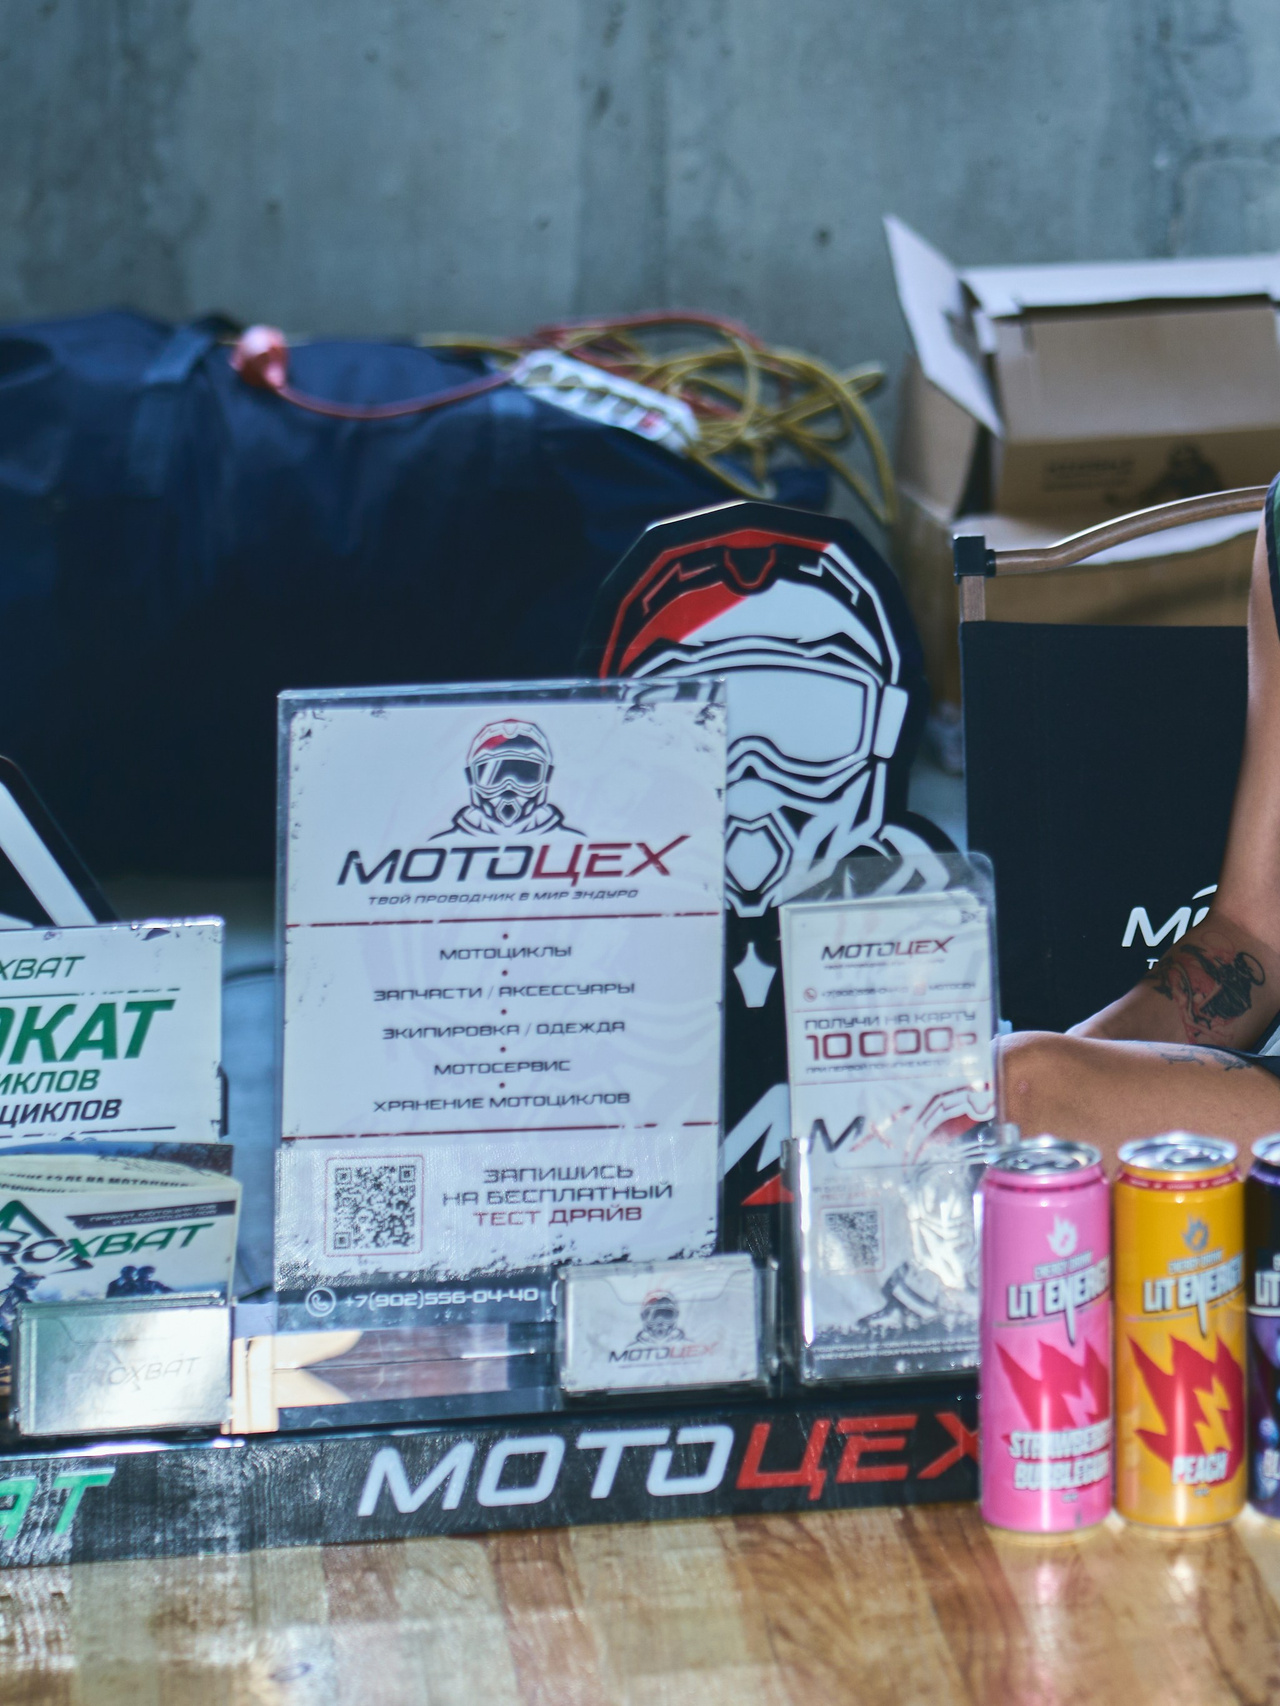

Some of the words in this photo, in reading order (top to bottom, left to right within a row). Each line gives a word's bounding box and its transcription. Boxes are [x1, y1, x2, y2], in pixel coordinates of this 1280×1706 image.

[337, 835, 691, 887] МОТОЦЕХ
[368, 894, 411, 906] ТВОЙ
[414, 892, 516, 905] ПРОВОДНИК
[519, 891, 530, 902] В
[533, 890, 569, 902] МИР
[572, 888, 639, 901] ЭНДУРО
[439, 945, 573, 961] МОТОЦИКЛЫ
[821, 936, 956, 961] МОТОЦЕХ
[373, 986, 483, 1002] ЗАПЧАСТИ
[499, 982, 636, 998] АКСЕССУАРЫ
[382, 1023, 520, 1040] ЭКИПИРОВКА
[536, 1021, 626, 1038] ОДЕЖДА
[804, 1016, 879, 1031] ПОЛУЧИ
[884, 1014, 910, 1027] НА
[914, 1011, 976, 1025] КАРТУ
[434, 1059, 571, 1077] МОТОСЕРВИС
[373, 1096, 484, 1113] ХРАНЕНИЕ
[489, 1092, 632, 1109] МОТОЦИКЛОВ
[482, 1162, 634, 1184] ЗАПИШИСЬ
[442, 1191, 480, 1207] НА
[486, 1181, 674, 1206] БЕСПЛАТНЫЙ
[473, 1210, 542, 1228] ТЕСТ
[547, 1203, 644, 1228] ДРАЙВ
[344, 1287, 539, 1311] +7(902)556-04-40
[608, 1340, 719, 1363] МОТОЦЕХ
[357, 1413, 982, 1518] МОТОЦЕХ
